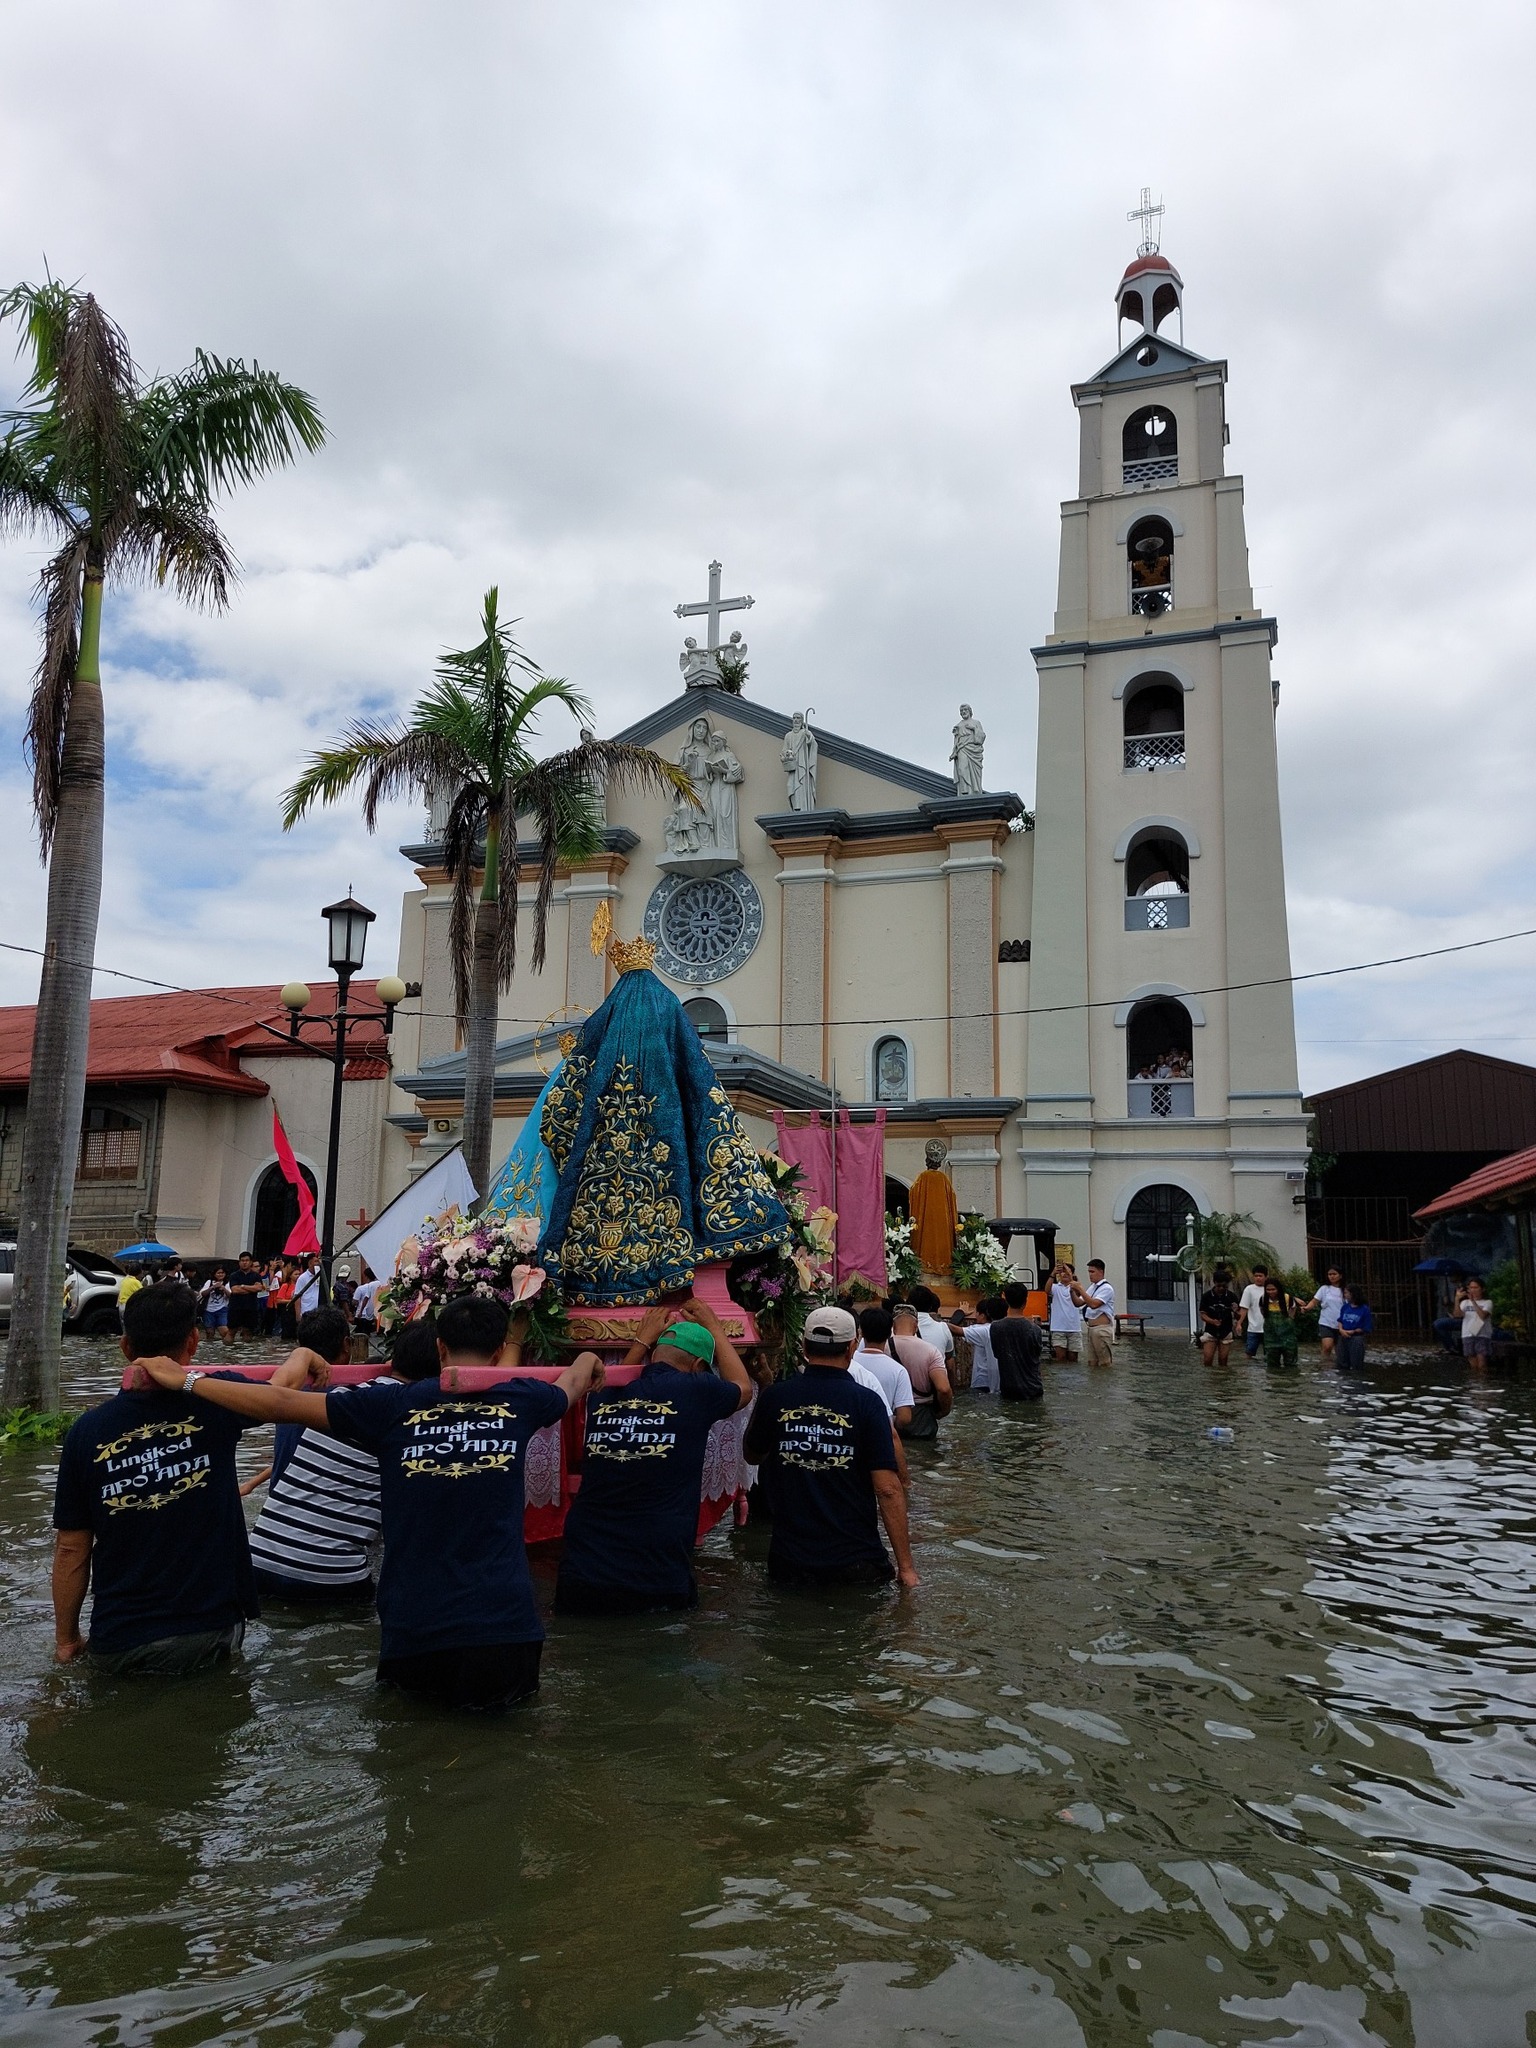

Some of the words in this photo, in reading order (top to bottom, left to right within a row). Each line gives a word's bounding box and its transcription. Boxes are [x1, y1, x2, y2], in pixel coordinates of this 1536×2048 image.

[413, 1418, 504, 1436] Lingkod
[596, 1415, 665, 1426] Lingkod
[620, 1425, 635, 1433] ni
[785, 1422, 843, 1436] Lingkod
[448, 1430, 468, 1442] ni
[587, 1432, 623, 1443] APO
[807, 1434, 820, 1442] ni
[401, 1442, 454, 1460] APO
[779, 1440, 812, 1451] APO
[106, 1436, 192, 1472] Lingkod
[141, 1459, 160, 1474] ni
[101, 1474, 149, 1498] APO
